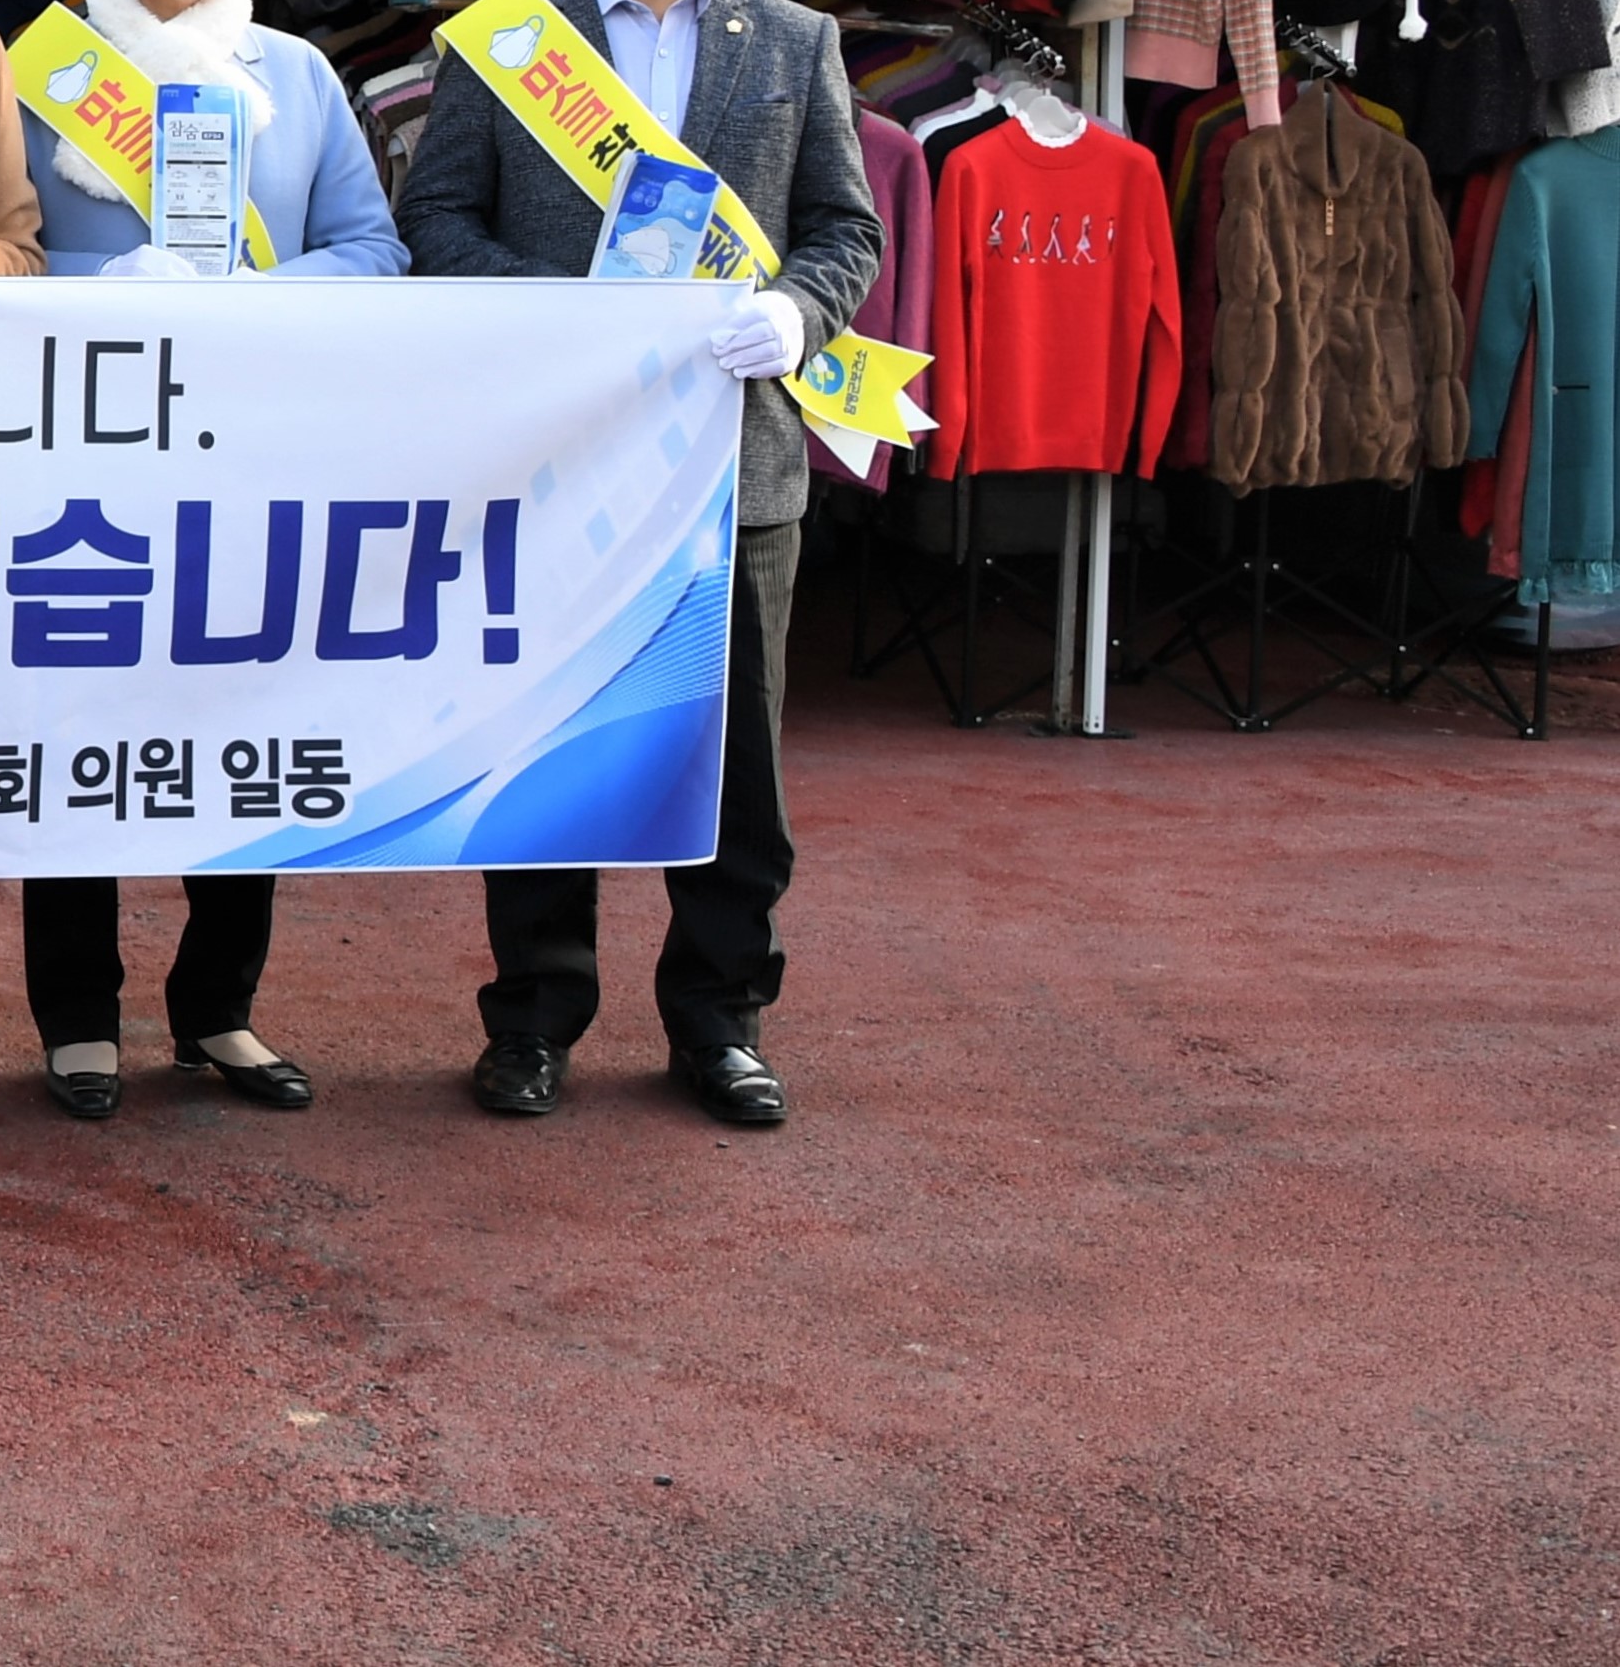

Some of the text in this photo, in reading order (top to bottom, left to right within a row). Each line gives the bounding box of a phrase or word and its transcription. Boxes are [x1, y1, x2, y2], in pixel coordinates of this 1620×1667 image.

[519, 48, 614, 149] 마스크
[67, 737, 196, 822] 의원
[221, 737, 352, 822] 일동
